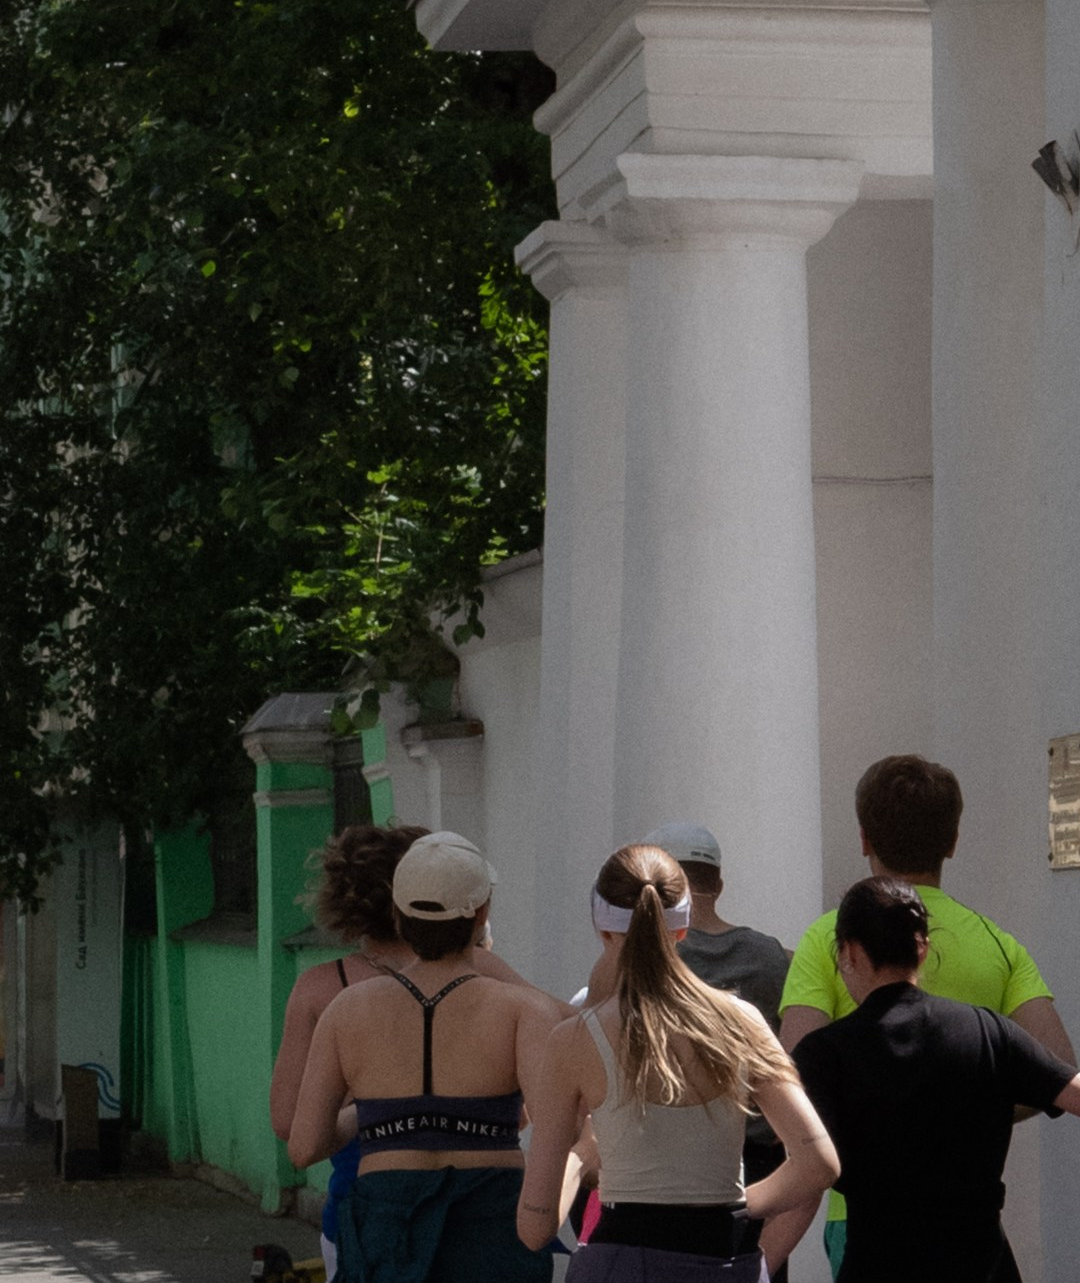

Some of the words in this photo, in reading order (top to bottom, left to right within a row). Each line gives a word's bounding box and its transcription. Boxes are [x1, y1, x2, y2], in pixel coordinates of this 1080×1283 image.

[76, 947, 87, 970] Сад
[375, 1117, 415, 1138] NIKE
[419, 1116, 448, 1129] AIR
[457, 1120, 499, 1137] NIKE
